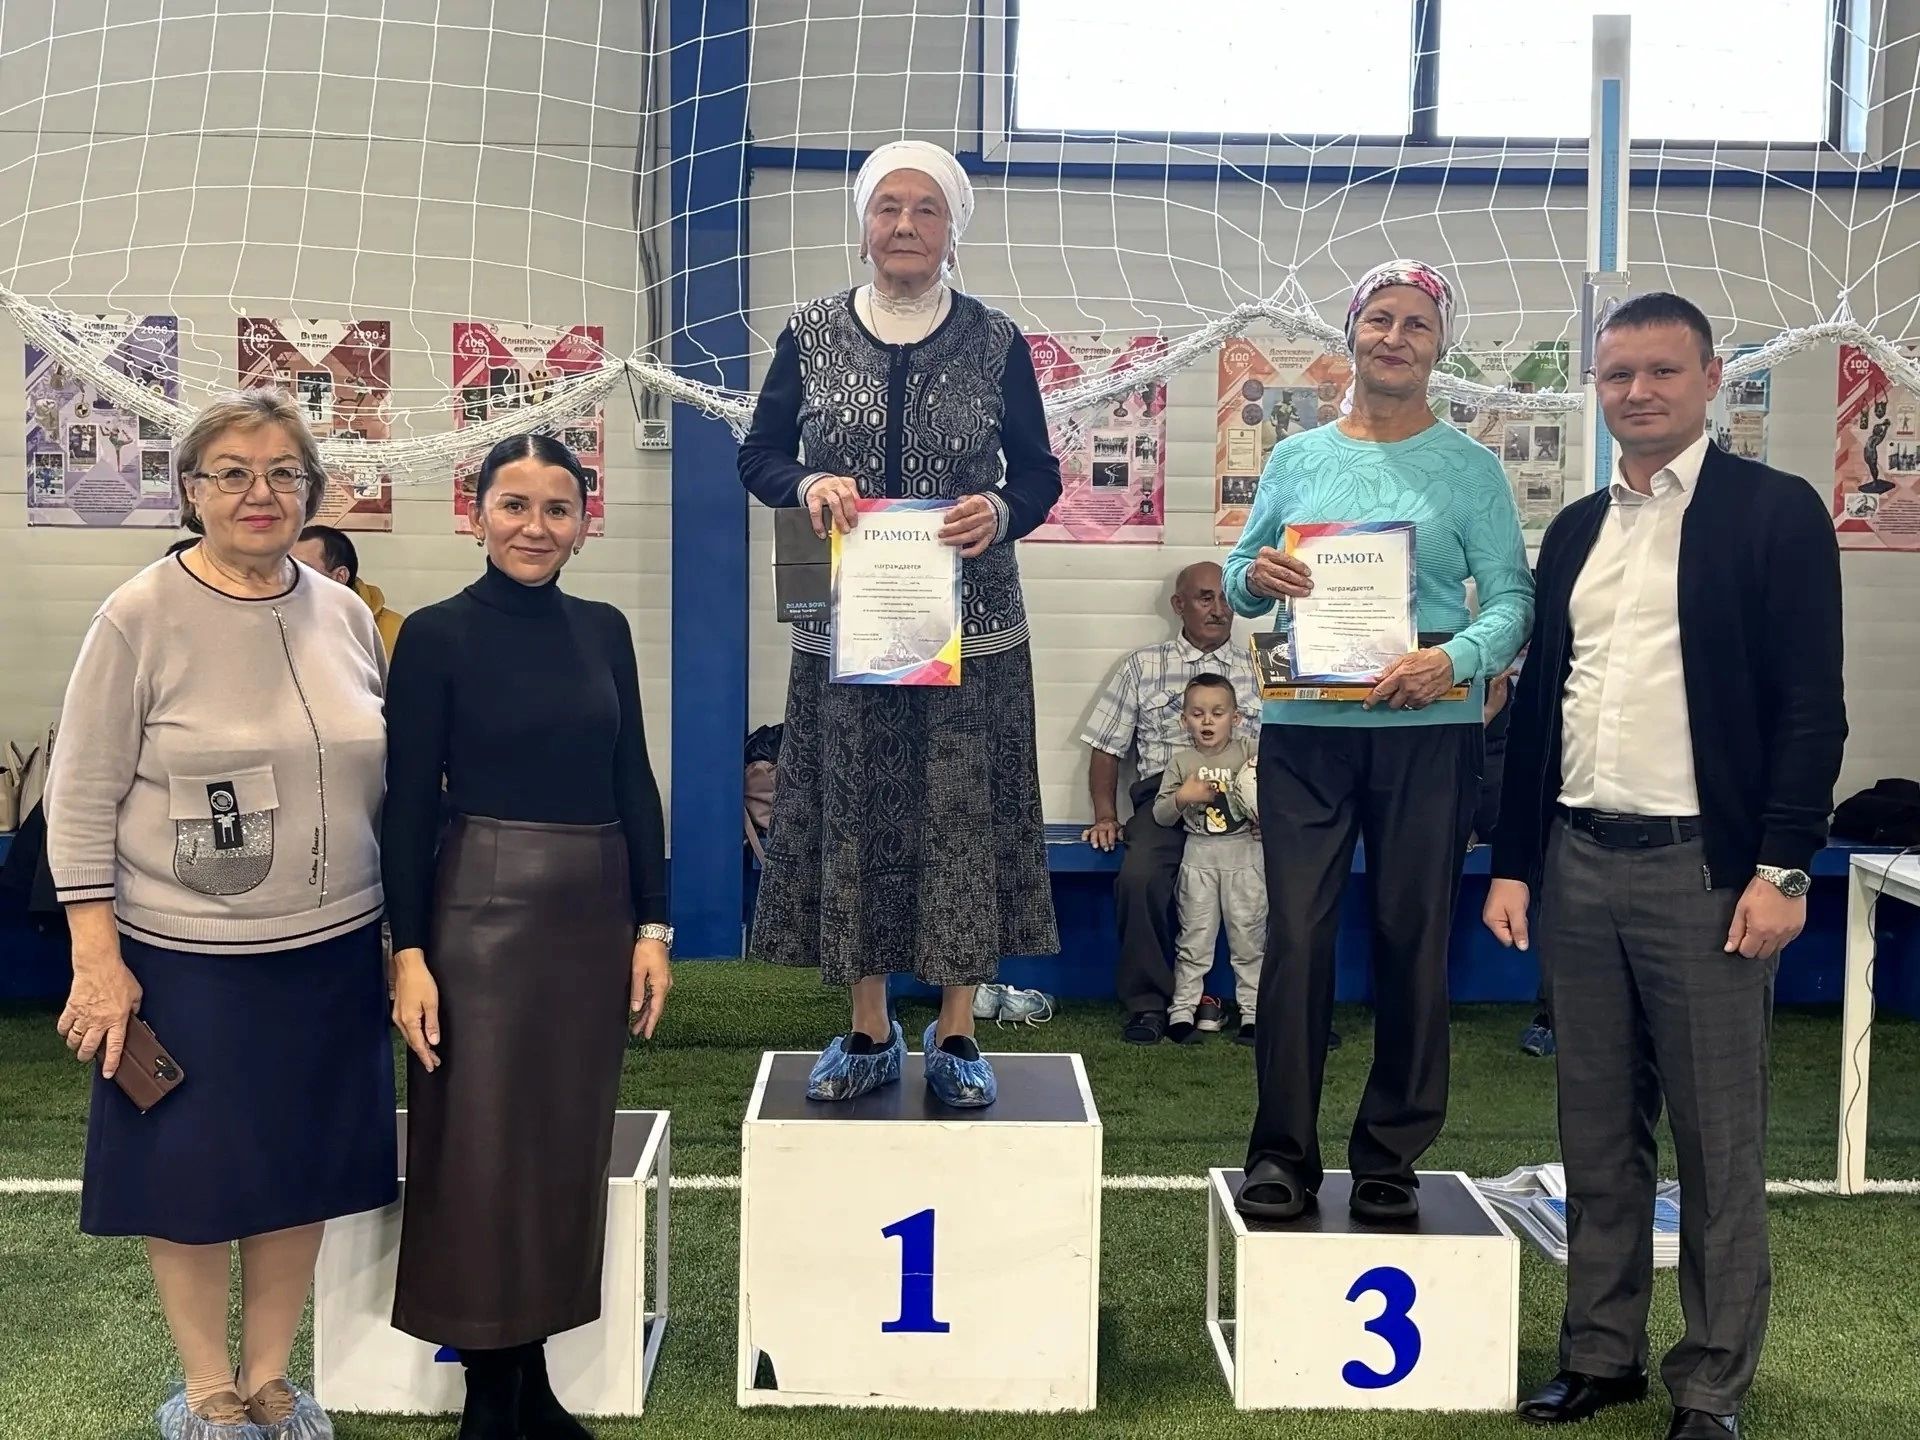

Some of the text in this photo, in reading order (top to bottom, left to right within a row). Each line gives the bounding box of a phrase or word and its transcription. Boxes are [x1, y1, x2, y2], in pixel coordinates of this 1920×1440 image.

[1033, 349, 1053, 359] 100
[1230, 353, 1249, 362] 100
[1850, 360, 1870, 369] 100
[864, 530, 931, 541] ГРАМОТА
[1317, 552, 1384, 564] ГРАМОТА
[1199, 766, 1231, 781] FUN
[881, 1208, 950, 1333] 1
[1342, 1266, 1421, 1388] 3
